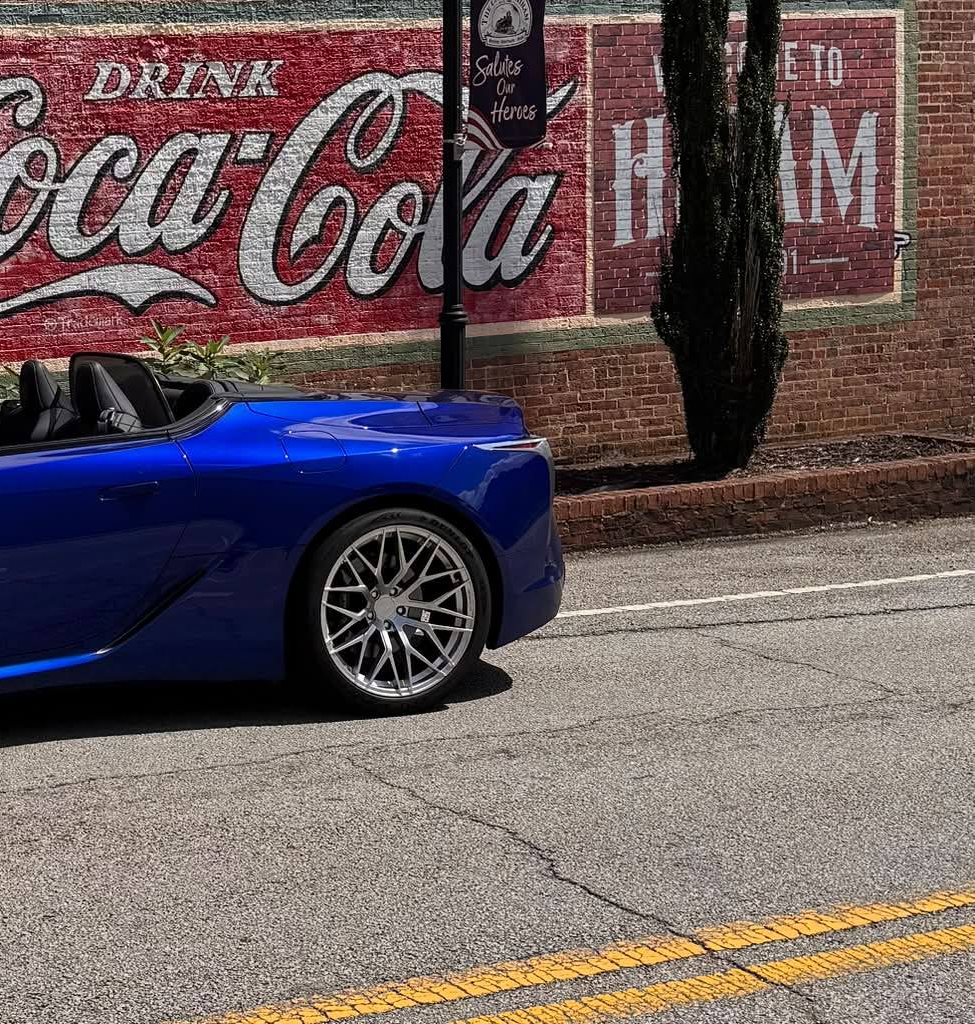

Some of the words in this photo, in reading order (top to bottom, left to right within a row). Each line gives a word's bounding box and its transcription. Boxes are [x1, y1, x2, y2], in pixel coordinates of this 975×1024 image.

[83, 59, 285, 101] DRINK
[472, 50, 524, 87] Salutes
[810, 44, 843, 87] TO
[496, 77, 516, 96] Our
[490, 96, 538, 124] Heroes
[611, 103, 880, 247] HAM
